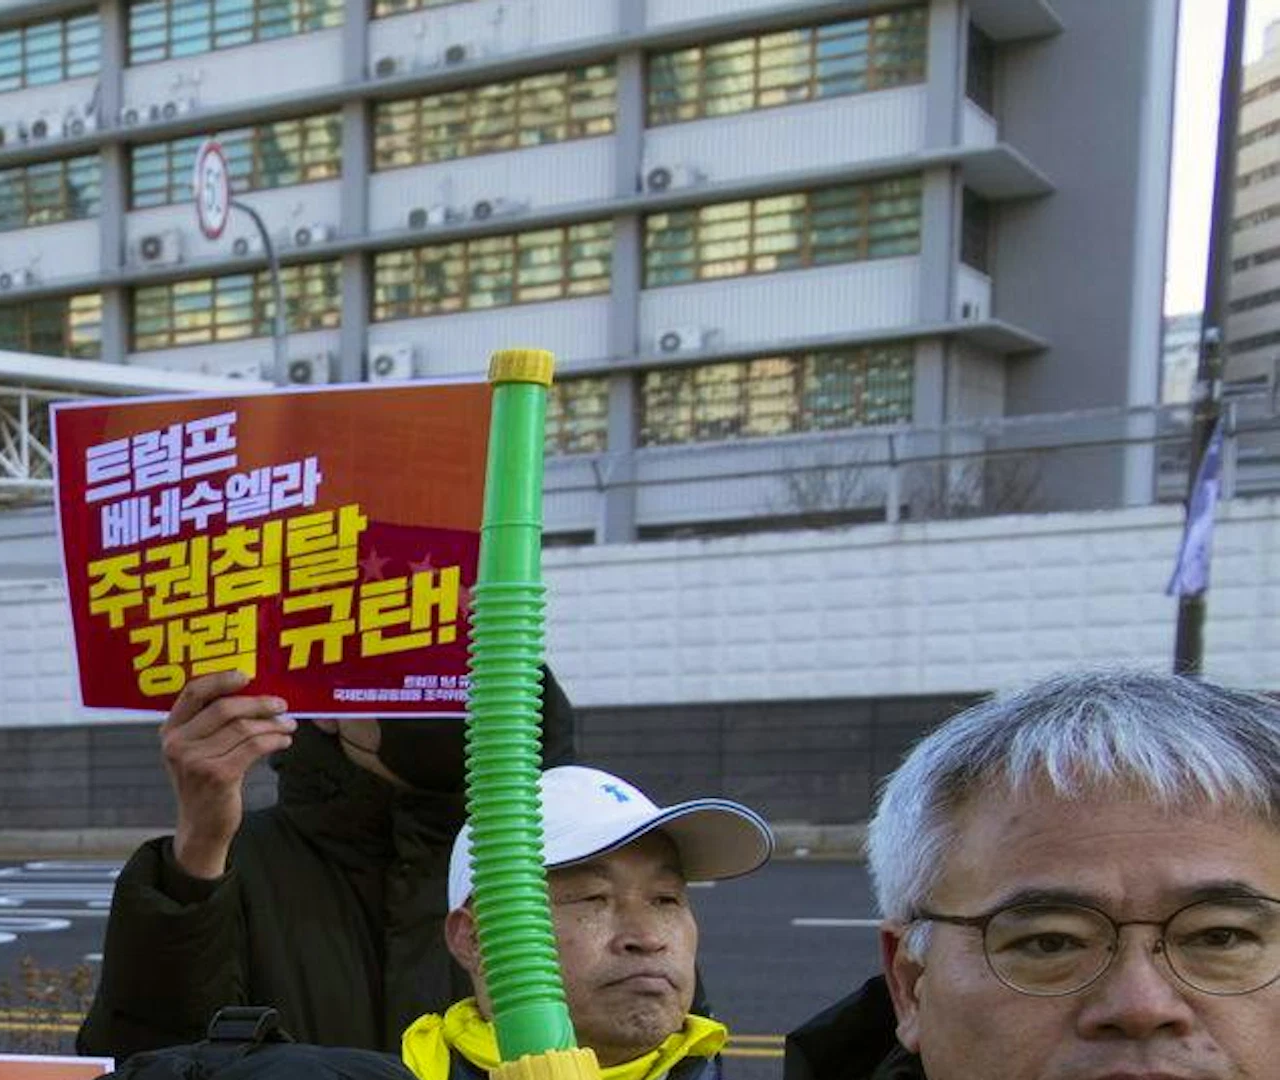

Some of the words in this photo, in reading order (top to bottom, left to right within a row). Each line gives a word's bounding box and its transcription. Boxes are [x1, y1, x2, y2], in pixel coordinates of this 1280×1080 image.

[85, 411, 238, 503] 트럼프
[100, 456, 323, 549] 베네수엘라
[87, 503, 368, 629] 주권침탈
[129, 604, 258, 697] 강력
[279, 565, 461, 671] 규탄!
